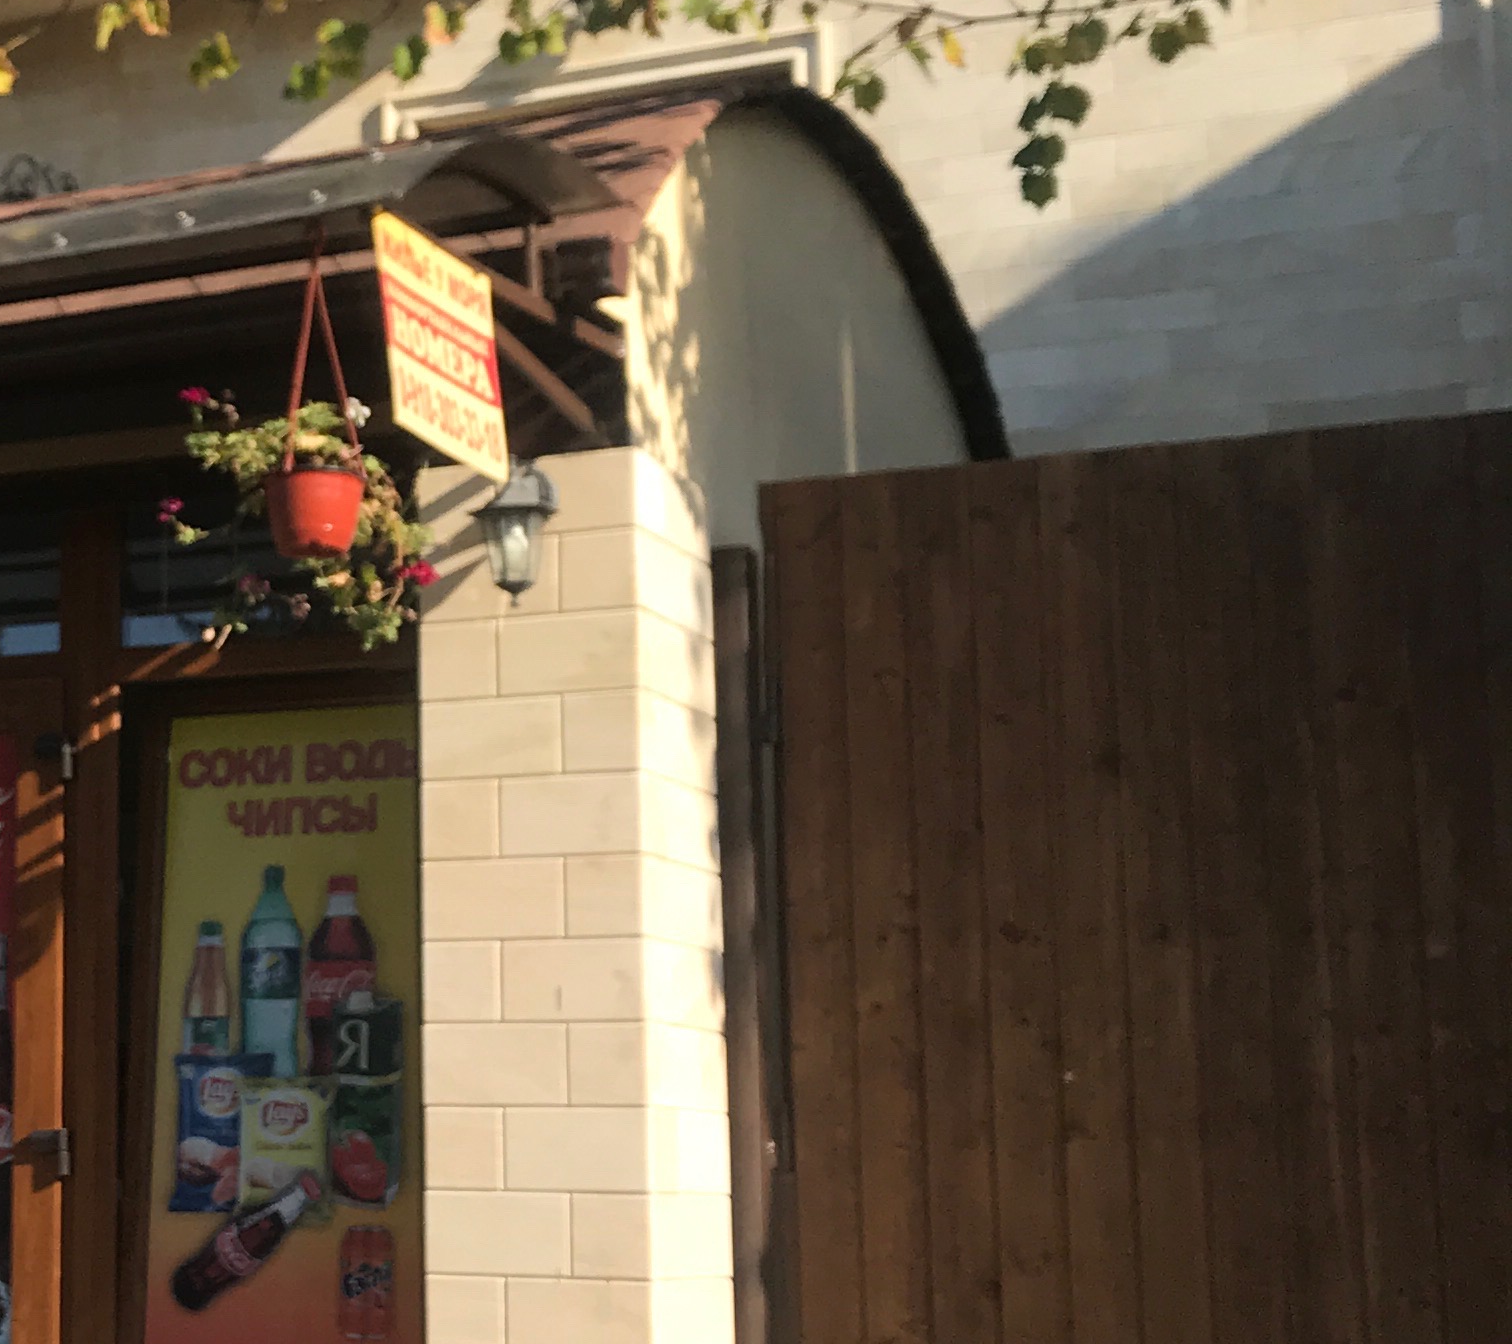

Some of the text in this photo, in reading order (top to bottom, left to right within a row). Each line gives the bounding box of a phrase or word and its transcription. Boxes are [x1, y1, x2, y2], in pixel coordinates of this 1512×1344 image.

[391, 303, 496, 400] НОМЕРА
[179, 744, 293, 789] СОКИ
[226, 792, 378, 837] ЧИПСЫ
